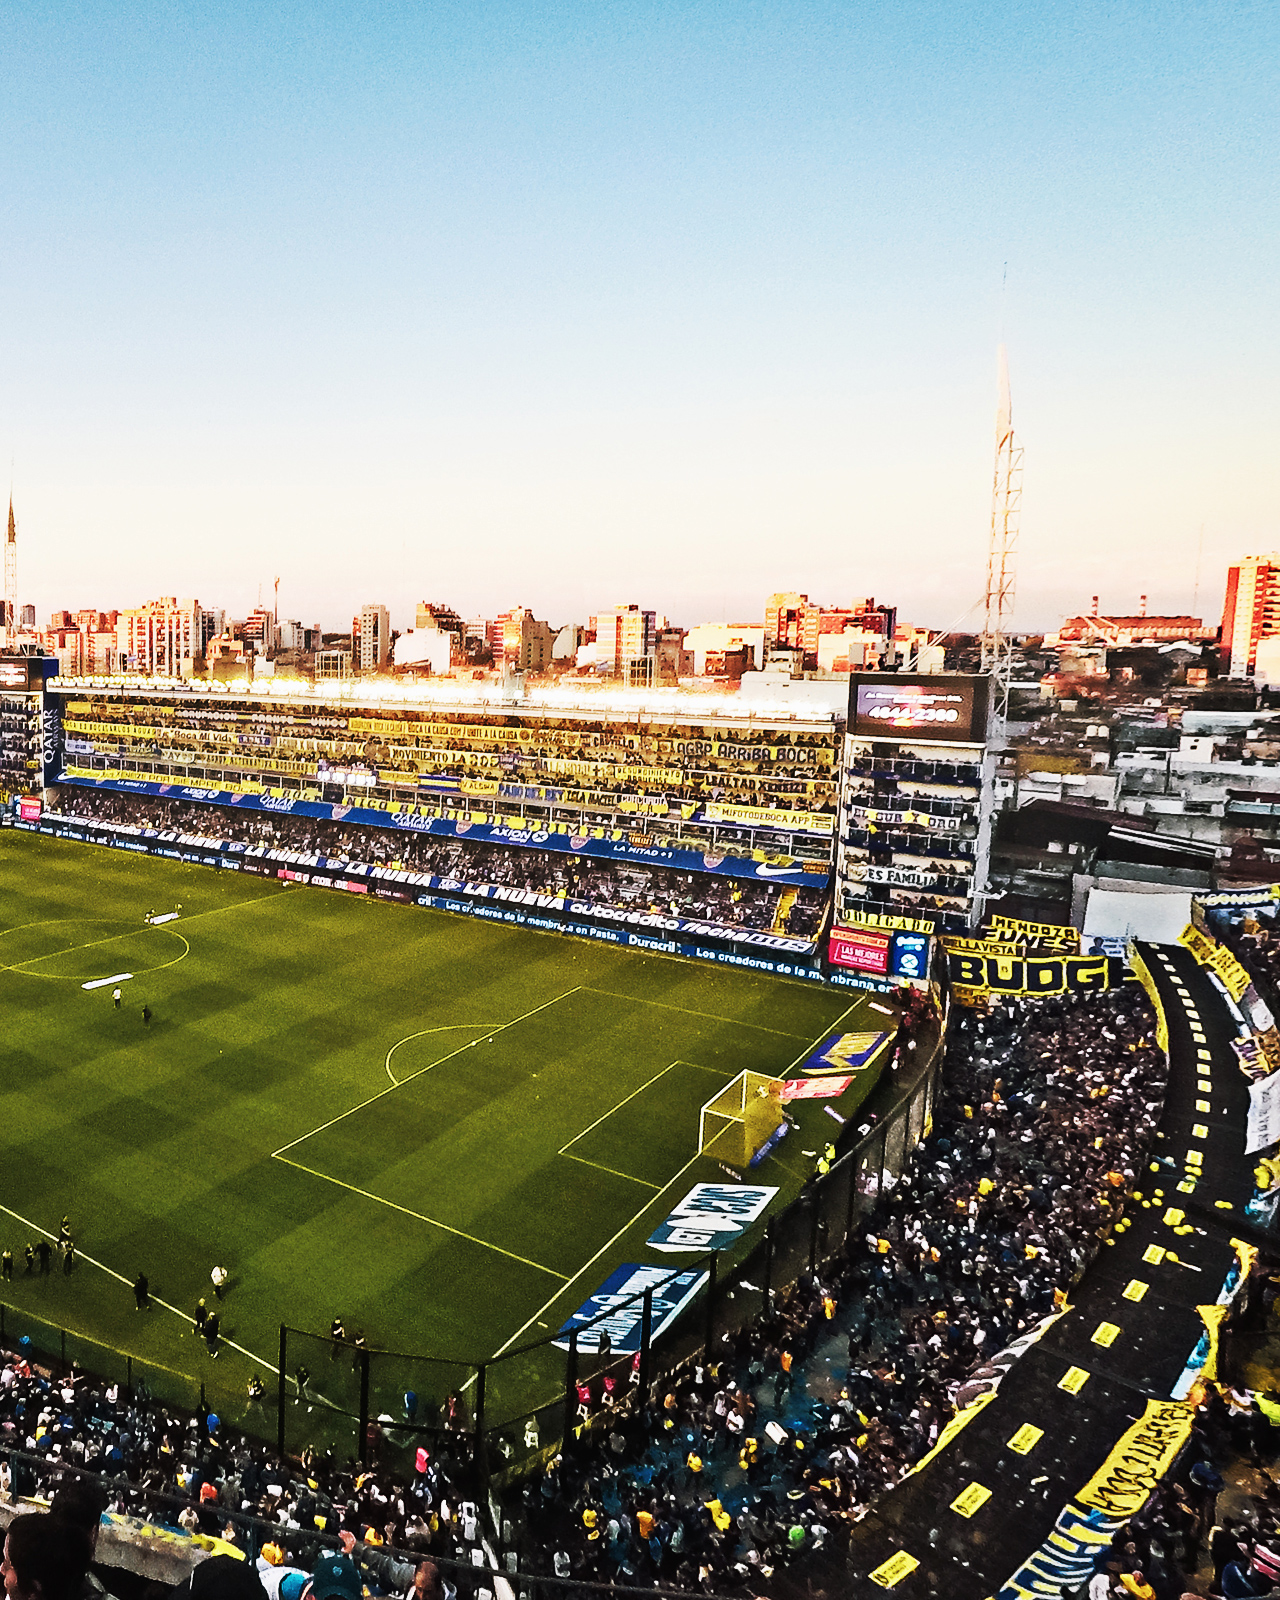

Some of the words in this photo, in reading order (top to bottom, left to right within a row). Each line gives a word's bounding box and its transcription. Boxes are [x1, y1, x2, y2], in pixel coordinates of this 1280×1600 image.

[44, 709, 55, 763] QATAR
[499, 731, 518, 740] CAUSA
[393, 749, 448, 763] MOVIMIENTO
[776, 748, 817, 764] BOCA
[260, 795, 297, 808] QATAR
[391, 812, 436, 826] QATAR
[490, 827, 532, 840] AXION
[176, 834, 224, 850] NUEVA
[244, 845, 265, 857] LA
[266, 848, 320, 867] NUEVA
[614, 844, 626, 853] LA
[628, 846, 659, 857] MITAD
[660, 849, 674, 859] +1
[344, 862, 370, 876] LA
[370, 866, 433, 888] NUEVA
[463, 882, 491, 897] LA
[493, 887, 566, 910] NUEVA
[445, 901, 461, 912] Los
[504, 912, 516, 922] de
[575, 926, 588, 936] en
[995, 916, 1076, 940] MENDOZA
[841, 945, 854, 956] LAS
[854, 948, 885, 962] MEJORES
[696, 947, 715, 960] Los
[719, 953, 774, 971] creadores
[777, 962, 792, 974] de
[794, 965, 805, 977] la
